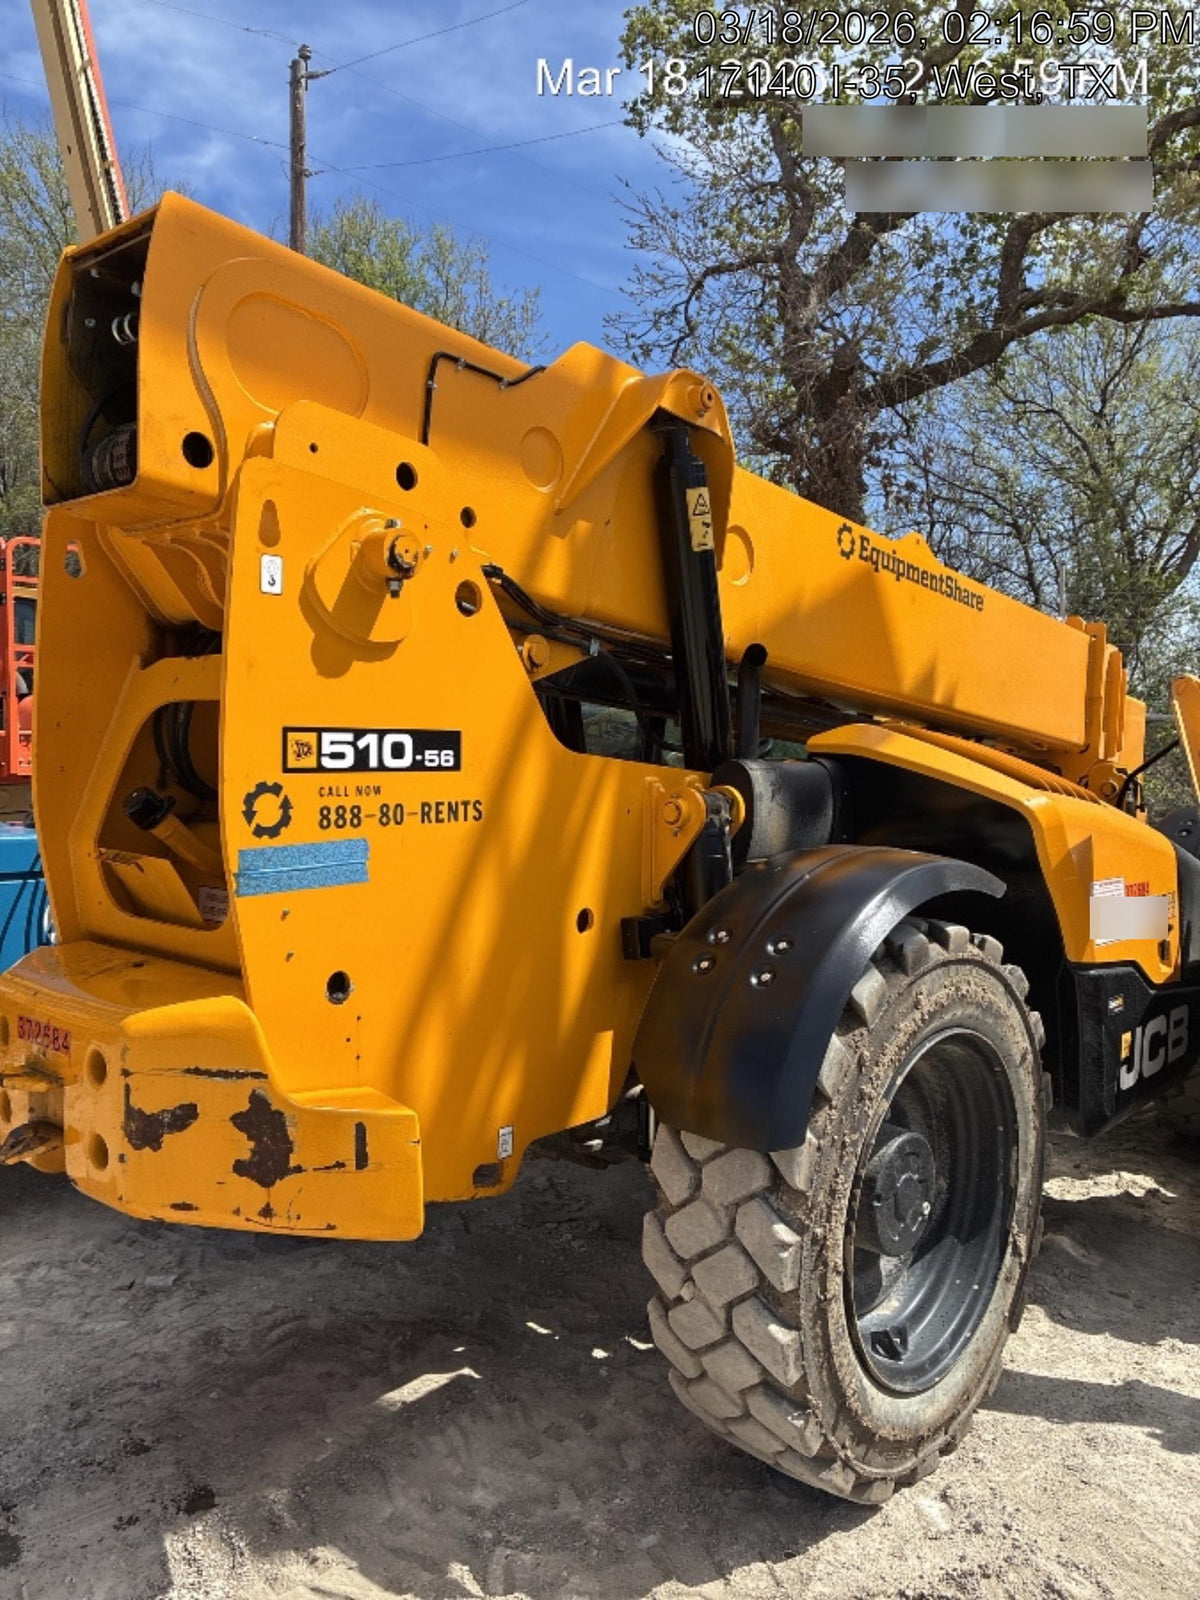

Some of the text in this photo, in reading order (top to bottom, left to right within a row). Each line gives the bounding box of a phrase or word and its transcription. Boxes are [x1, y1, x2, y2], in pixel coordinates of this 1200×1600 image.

[859, 535, 985, 612] EquipmentShare
[320, 731, 455, 769] 510-56
[319, 785, 382, 798] CALL NOW
[318, 800, 484, 830] 888-80-RENTS
[1119, 1003, 1190, 1091] JCB
